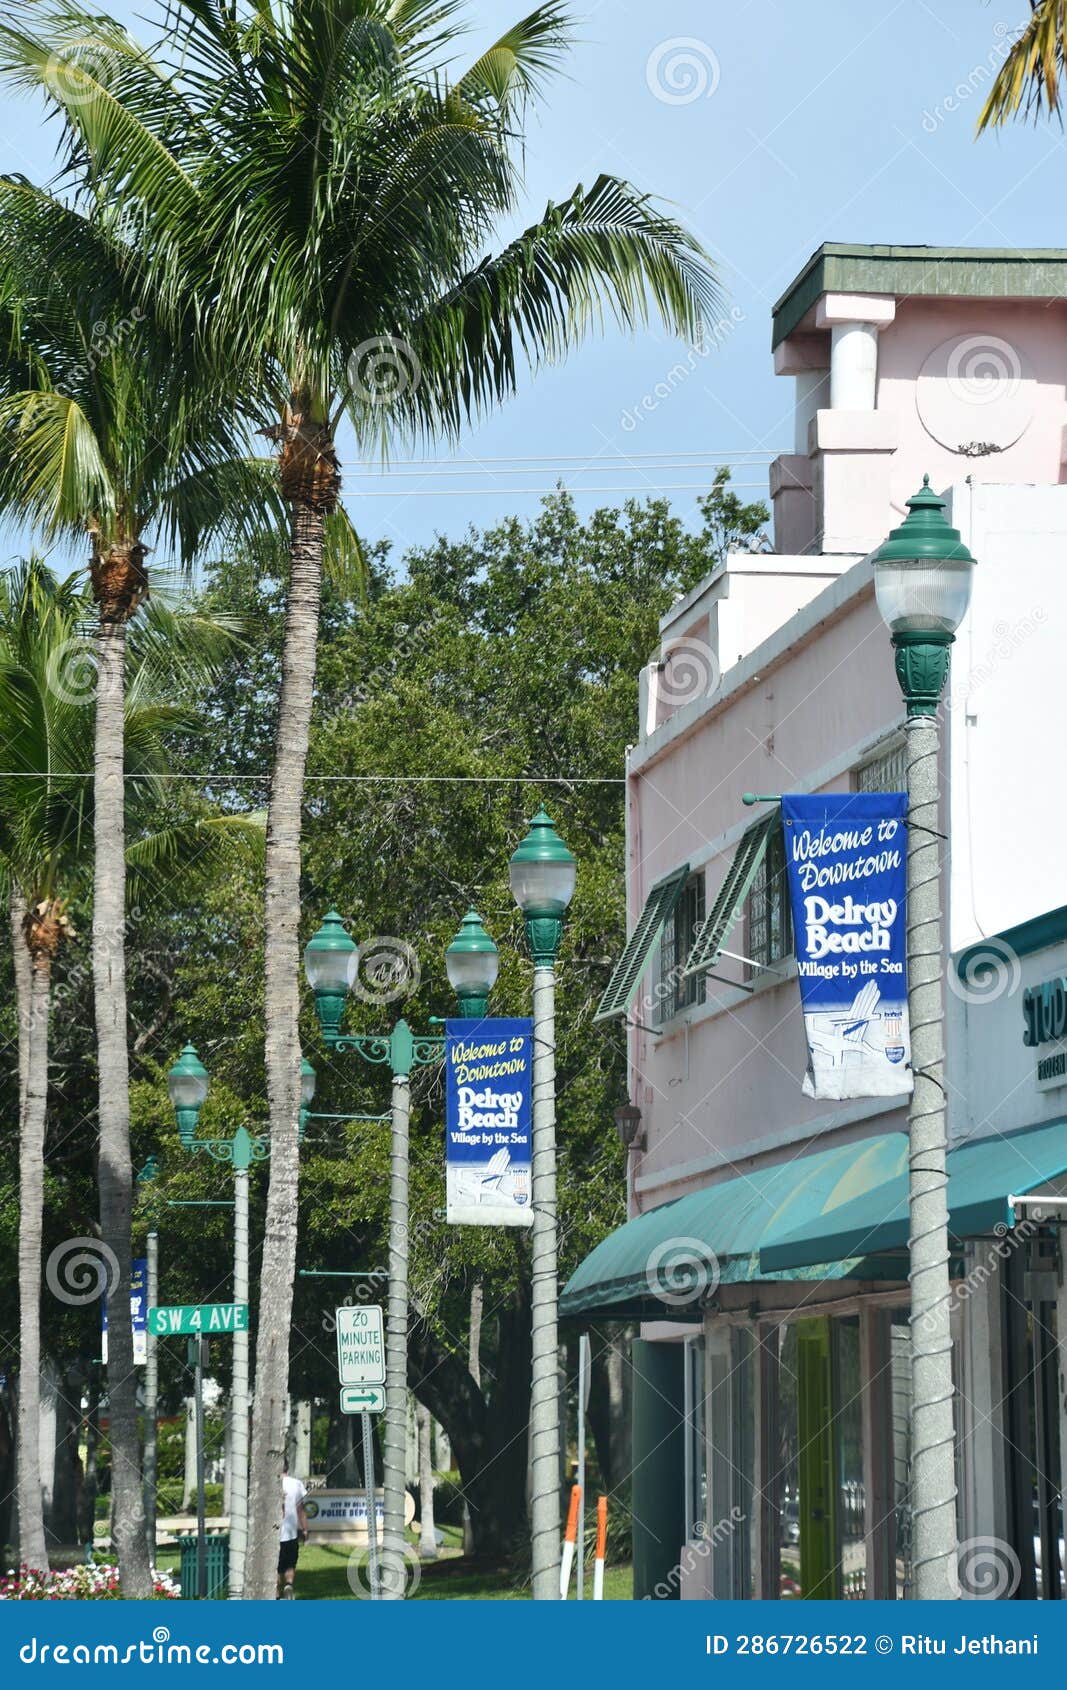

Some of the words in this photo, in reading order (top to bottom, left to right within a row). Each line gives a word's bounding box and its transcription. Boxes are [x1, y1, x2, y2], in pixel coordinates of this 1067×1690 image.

[792, 826, 873, 861] Welcome
[877, 819, 899, 842] to
[798, 850, 902, 892] Downtown
[803, 895, 898, 928] Delray
[805, 922, 891, 960] Beach
[798, 961, 840, 979] Village
[842, 962, 858, 979] by
[860, 960, 878, 974] the
[880, 958, 903, 974] Sea
[1022, 977, 1067, 1047] STUD
[451, 1042, 507, 1064] Welcome
[509, 1036, 525, 1052] to
[454, 1058, 527, 1086] Downtown
[457, 1086, 523, 1112] Delray
[457, 1107, 518, 1131] Beach
[450, 1132, 481, 1145] Village
[481, 1132, 494, 1145] by
[494, 1132, 509, 1144] the
[510, 1132, 528, 1144] Sea
[157, 1309, 183, 1331] SW
[190, 1310, 202, 1329] 4
[209, 1306, 244, 1329] AVE
[352, 1312, 368, 1327] 20
[341, 1330, 380, 1346] MINUTE
[343, 1350, 381, 1365] PARKING
[321, 1509, 347, 1517] POLICE
